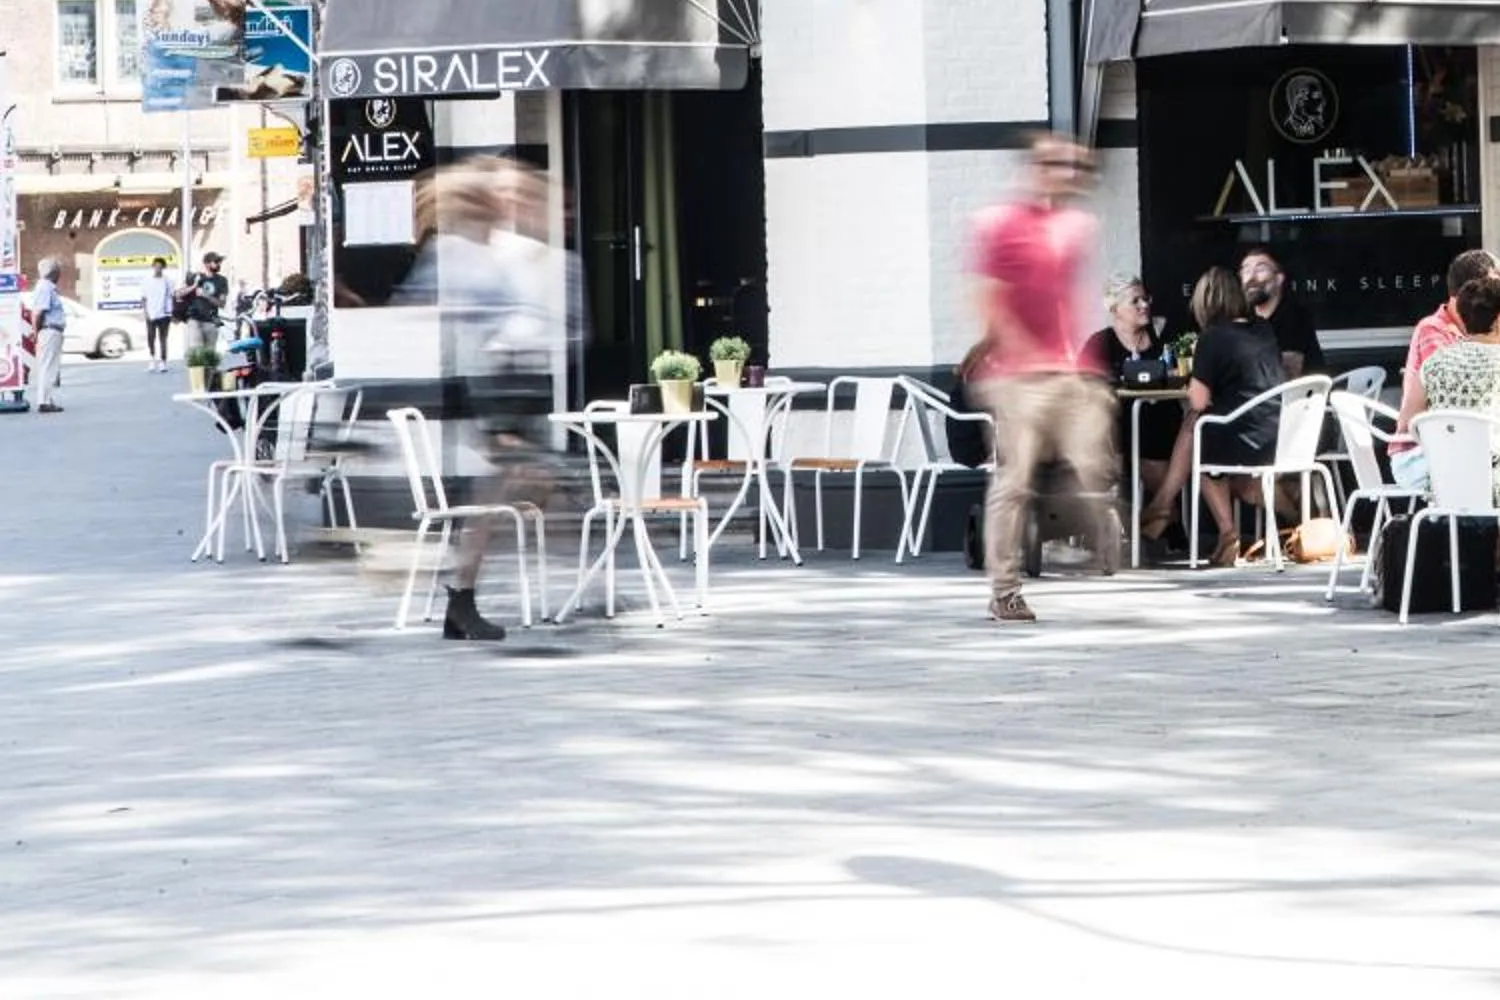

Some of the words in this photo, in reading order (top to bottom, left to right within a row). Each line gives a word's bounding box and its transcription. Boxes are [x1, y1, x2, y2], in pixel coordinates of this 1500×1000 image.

[341, 131, 421, 163] ALEX
[1214, 154, 1399, 216] ALEX
[1359, 274, 1441, 290] SLEEP
